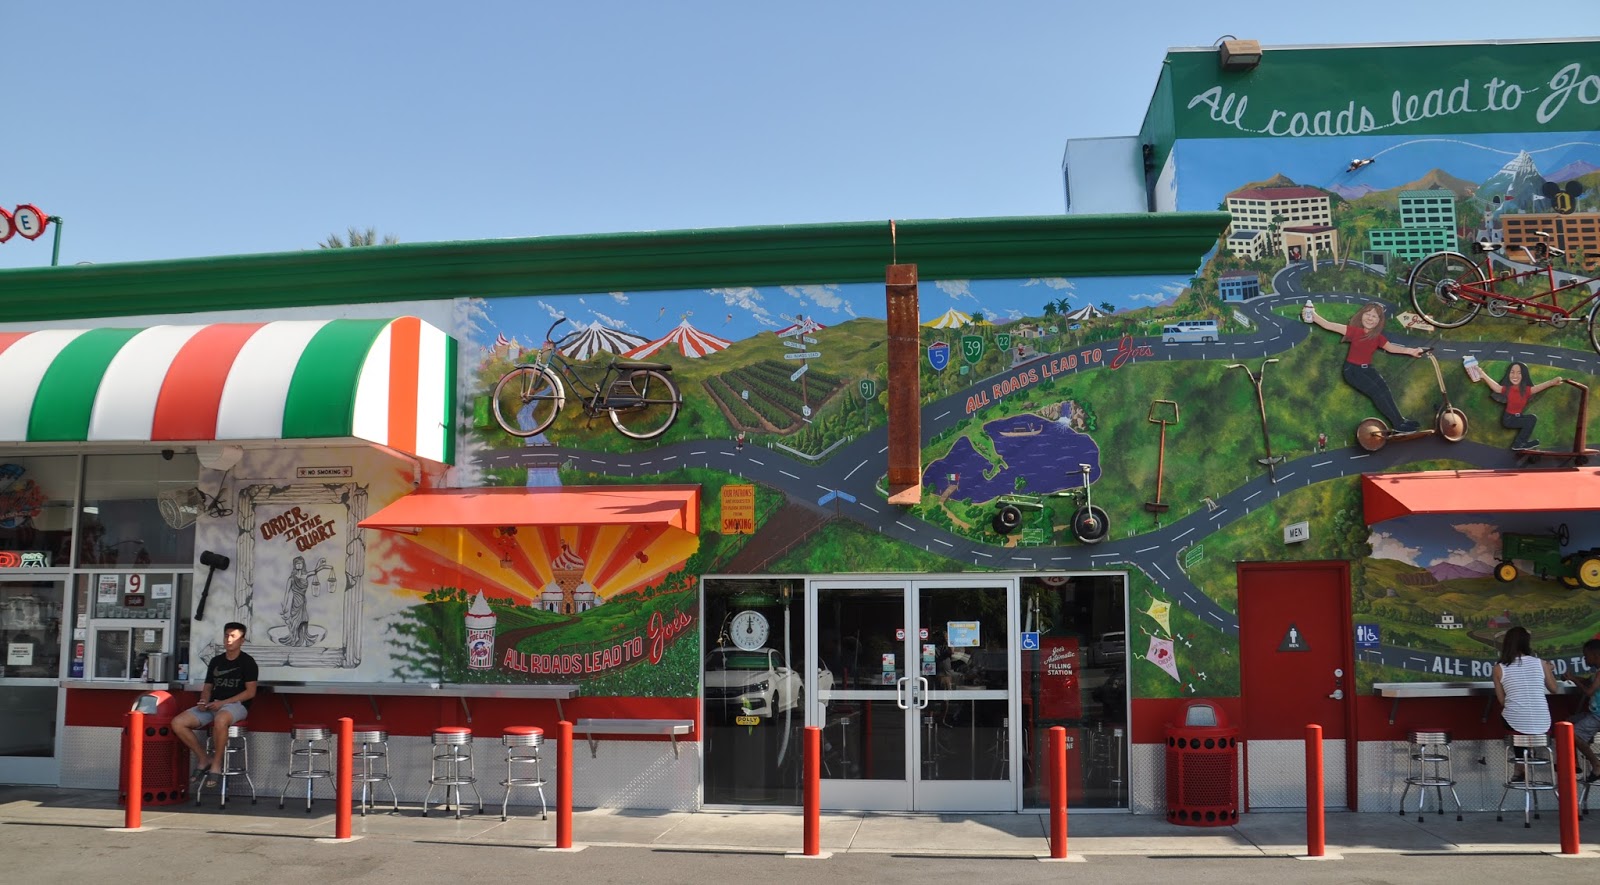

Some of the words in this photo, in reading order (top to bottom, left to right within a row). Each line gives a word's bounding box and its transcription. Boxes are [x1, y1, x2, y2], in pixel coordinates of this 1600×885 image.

[1187, 85, 1246, 130] All
[1389, 78, 1477, 124] lead
[1481, 76, 1523, 111] to
[20, 214, 31, 230] E
[1407, 314, 1427, 326] Joe
[965, 340, 981, 356] 39
[999, 336, 1008, 346] 22
[935, 350, 945, 364] 5
[965, 390, 990, 414] ALL
[992, 368, 1039, 400] ROADS
[1041, 353, 1077, 379] LEAD
[1081, 347, 1102, 365] TO
[1109, 335, 1154, 370] Joe's
[861, 382, 872, 396] 91
[724, 489, 732, 497] OUR
[732, 488, 752, 497] PATRONS
[260, 506, 309, 540] ORDER
[283, 525, 301, 542] IN
[300, 514, 322, 533] THE
[724, 518, 752, 530] SMOKING
[295, 519, 336, 552] QUART
[1289, 528, 1303, 538] MEN
[129, 573, 141, 593] 9
[503, 647, 529, 673] ALL
[530, 653, 582, 674] ROADS
[584, 644, 622, 673] LEAD
[623, 635, 643, 662] TO
[647, 608, 692, 665] Joe's
[1043, 651, 1076, 665] Automatic
[1052, 645, 1065, 657] Joe's
[1432, 656, 1463, 676] ALL
[213, 678, 241, 688] EAST
